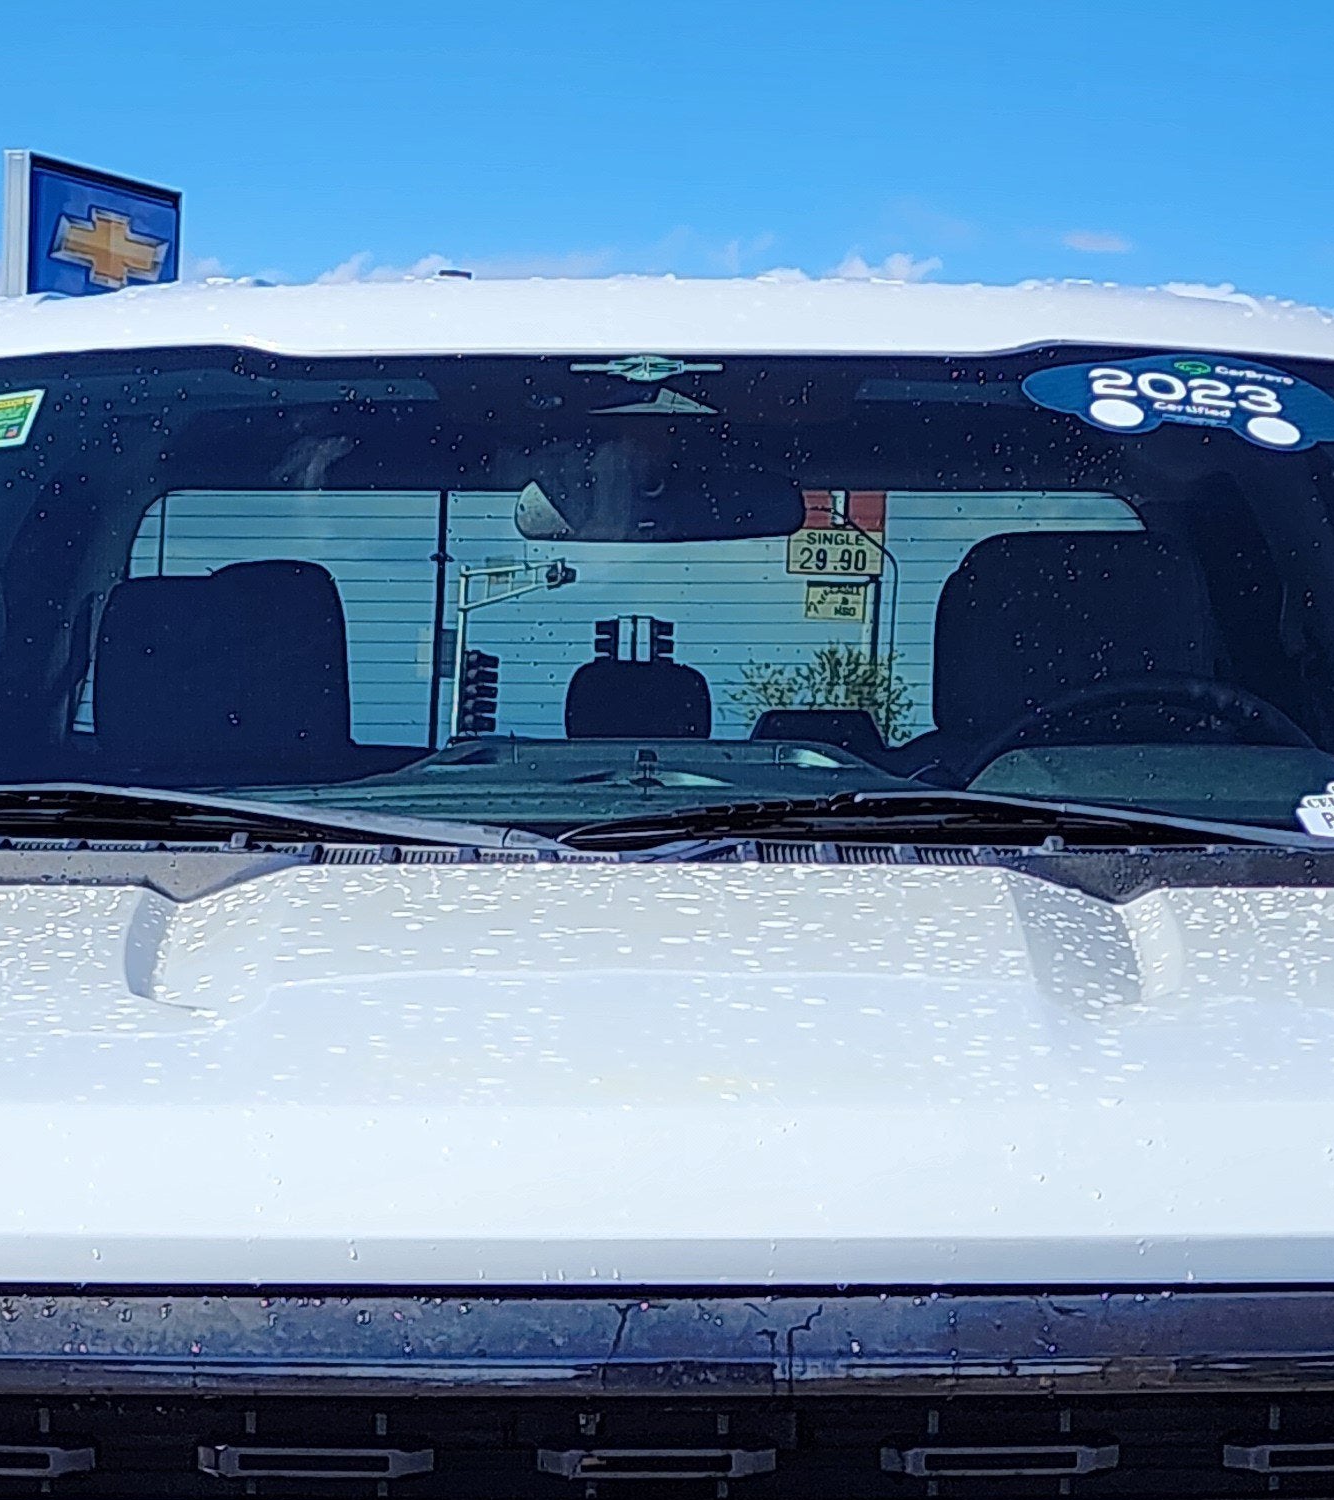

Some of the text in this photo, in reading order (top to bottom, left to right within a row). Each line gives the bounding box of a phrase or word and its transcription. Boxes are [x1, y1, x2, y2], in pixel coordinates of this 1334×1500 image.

[1088, 368, 1283, 413] 2023
[1153, 401, 1232, 418] Certified
[806, 532, 866, 546] SINGLE
[799, 547, 867, 571] 29.90
